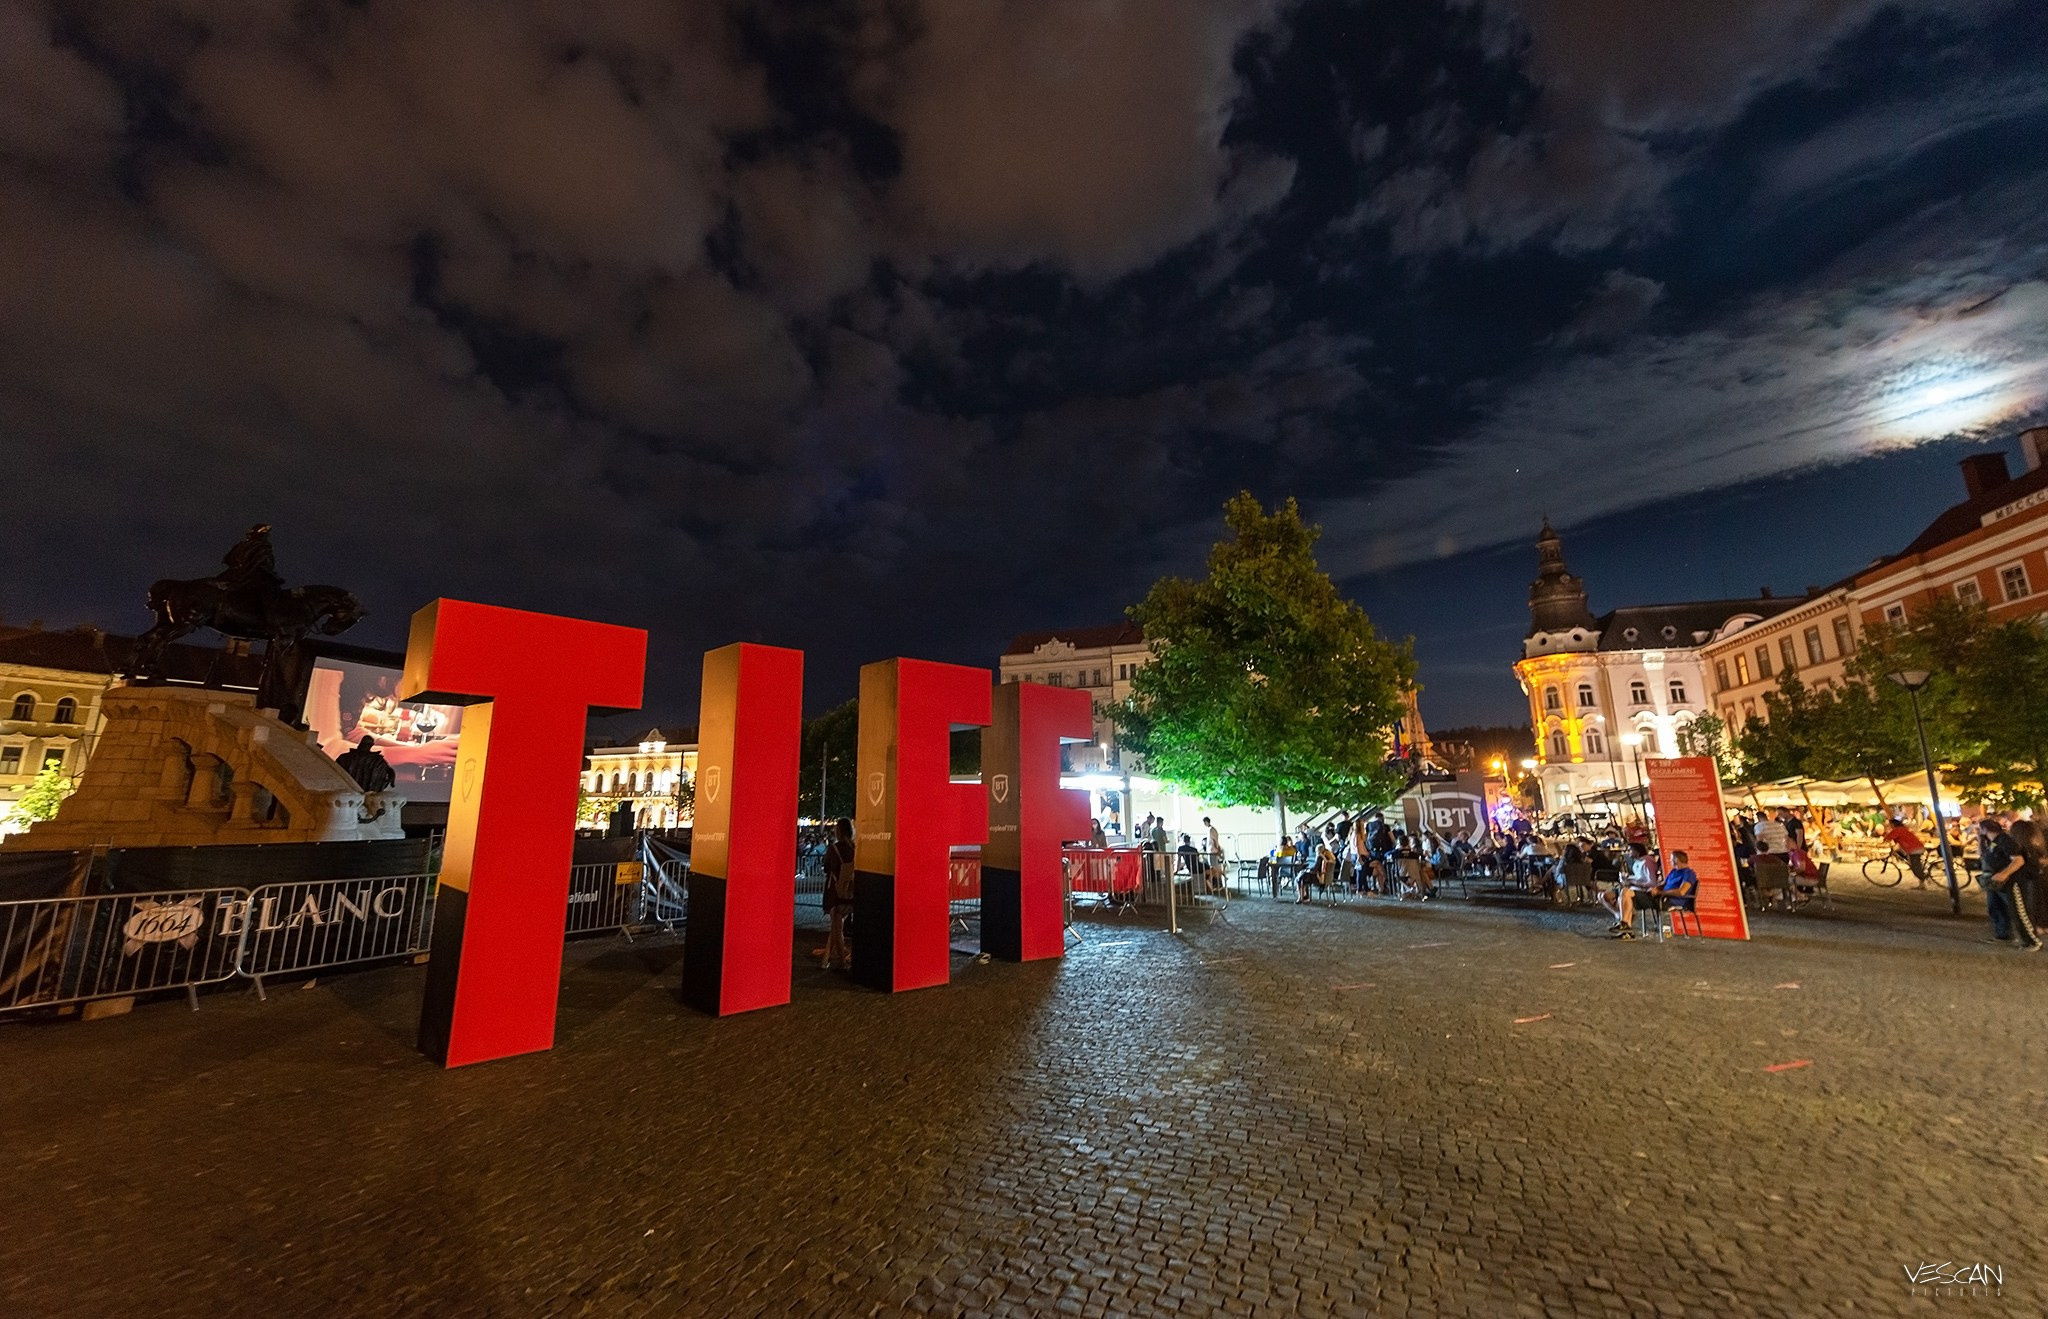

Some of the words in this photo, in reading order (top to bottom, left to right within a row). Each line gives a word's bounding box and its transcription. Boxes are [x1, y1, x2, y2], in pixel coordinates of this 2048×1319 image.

[707, 774, 718, 788] BT
[871, 780, 881, 791] BT
[995, 780, 1005, 791] BT
[1433, 807, 1470, 828] BT
[424, 598, 1092, 1070] TIFF
[134, 912, 193, 936] 1664
[218, 886, 406, 938] BLANC
